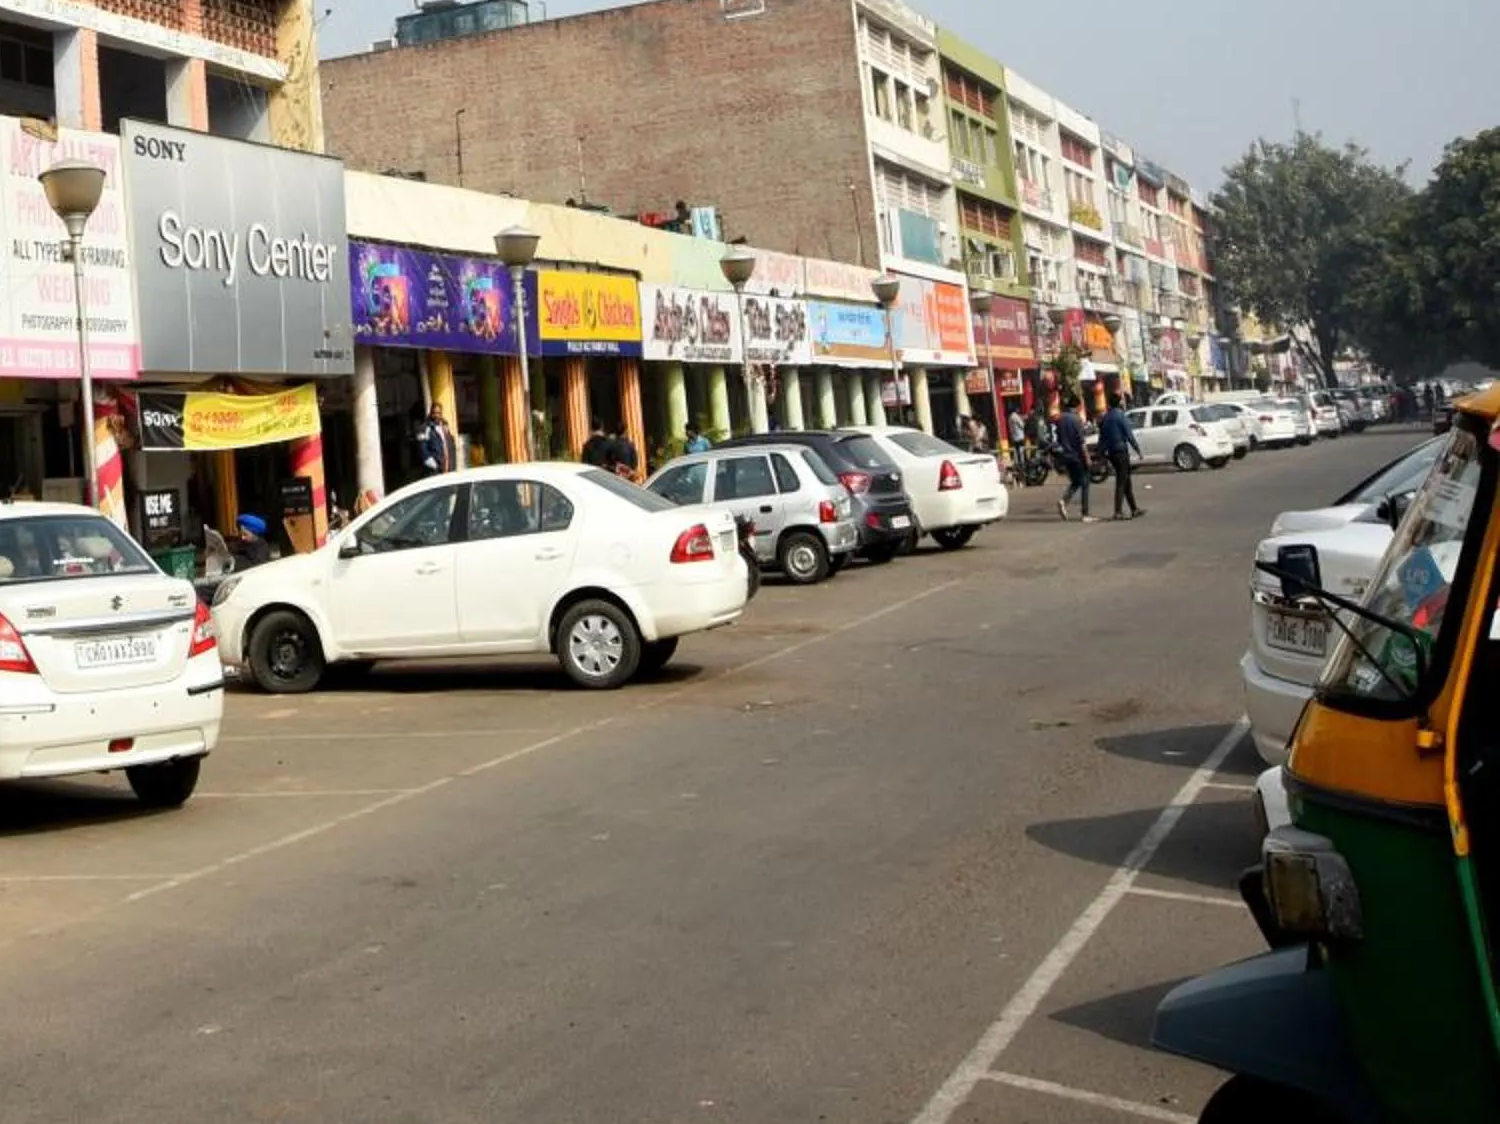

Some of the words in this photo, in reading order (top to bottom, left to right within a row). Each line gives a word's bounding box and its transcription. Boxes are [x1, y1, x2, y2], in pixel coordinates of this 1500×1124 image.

[133, 134, 188, 162] SONY
[12, 238, 32, 261] ALL
[158, 208, 239, 288] Sony
[246, 223, 338, 283] Center
[37, 274, 111, 307] WEDING
[21, 313, 73, 330] PHOTOGRAPHY
[143, 411, 183, 428] SONY
